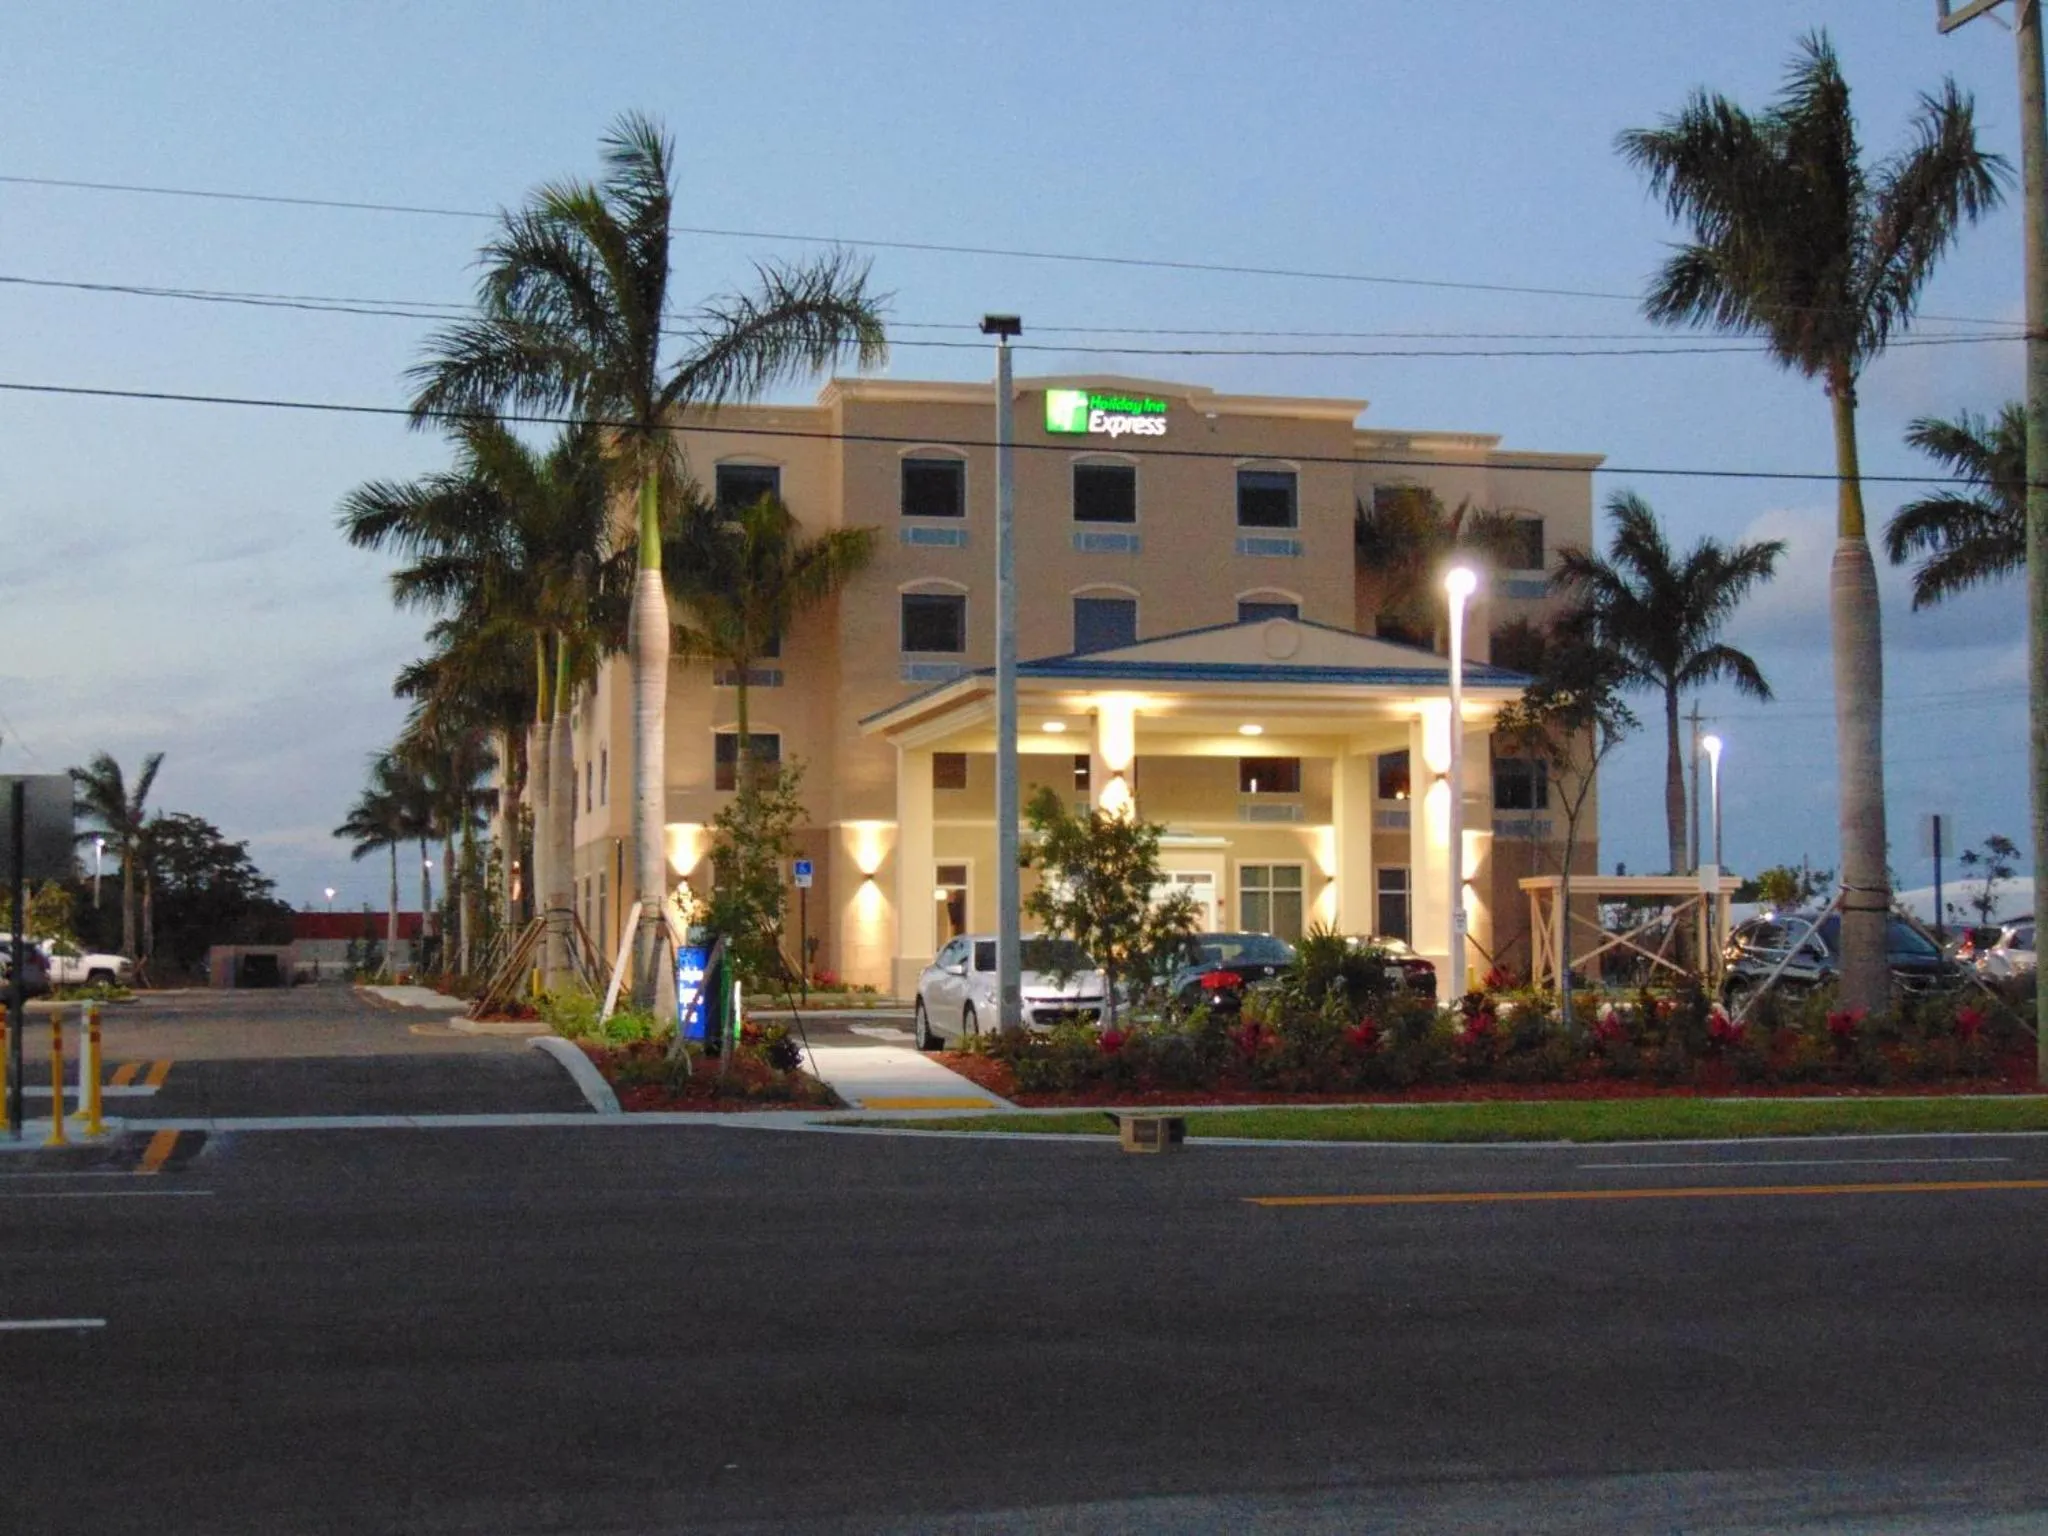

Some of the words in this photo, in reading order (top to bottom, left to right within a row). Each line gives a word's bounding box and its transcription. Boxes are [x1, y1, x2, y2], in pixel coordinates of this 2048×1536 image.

[1089, 395, 1142, 415] Holiday
[1143, 398, 1167, 413] Inn
[1088, 410, 1166, 438] Express
